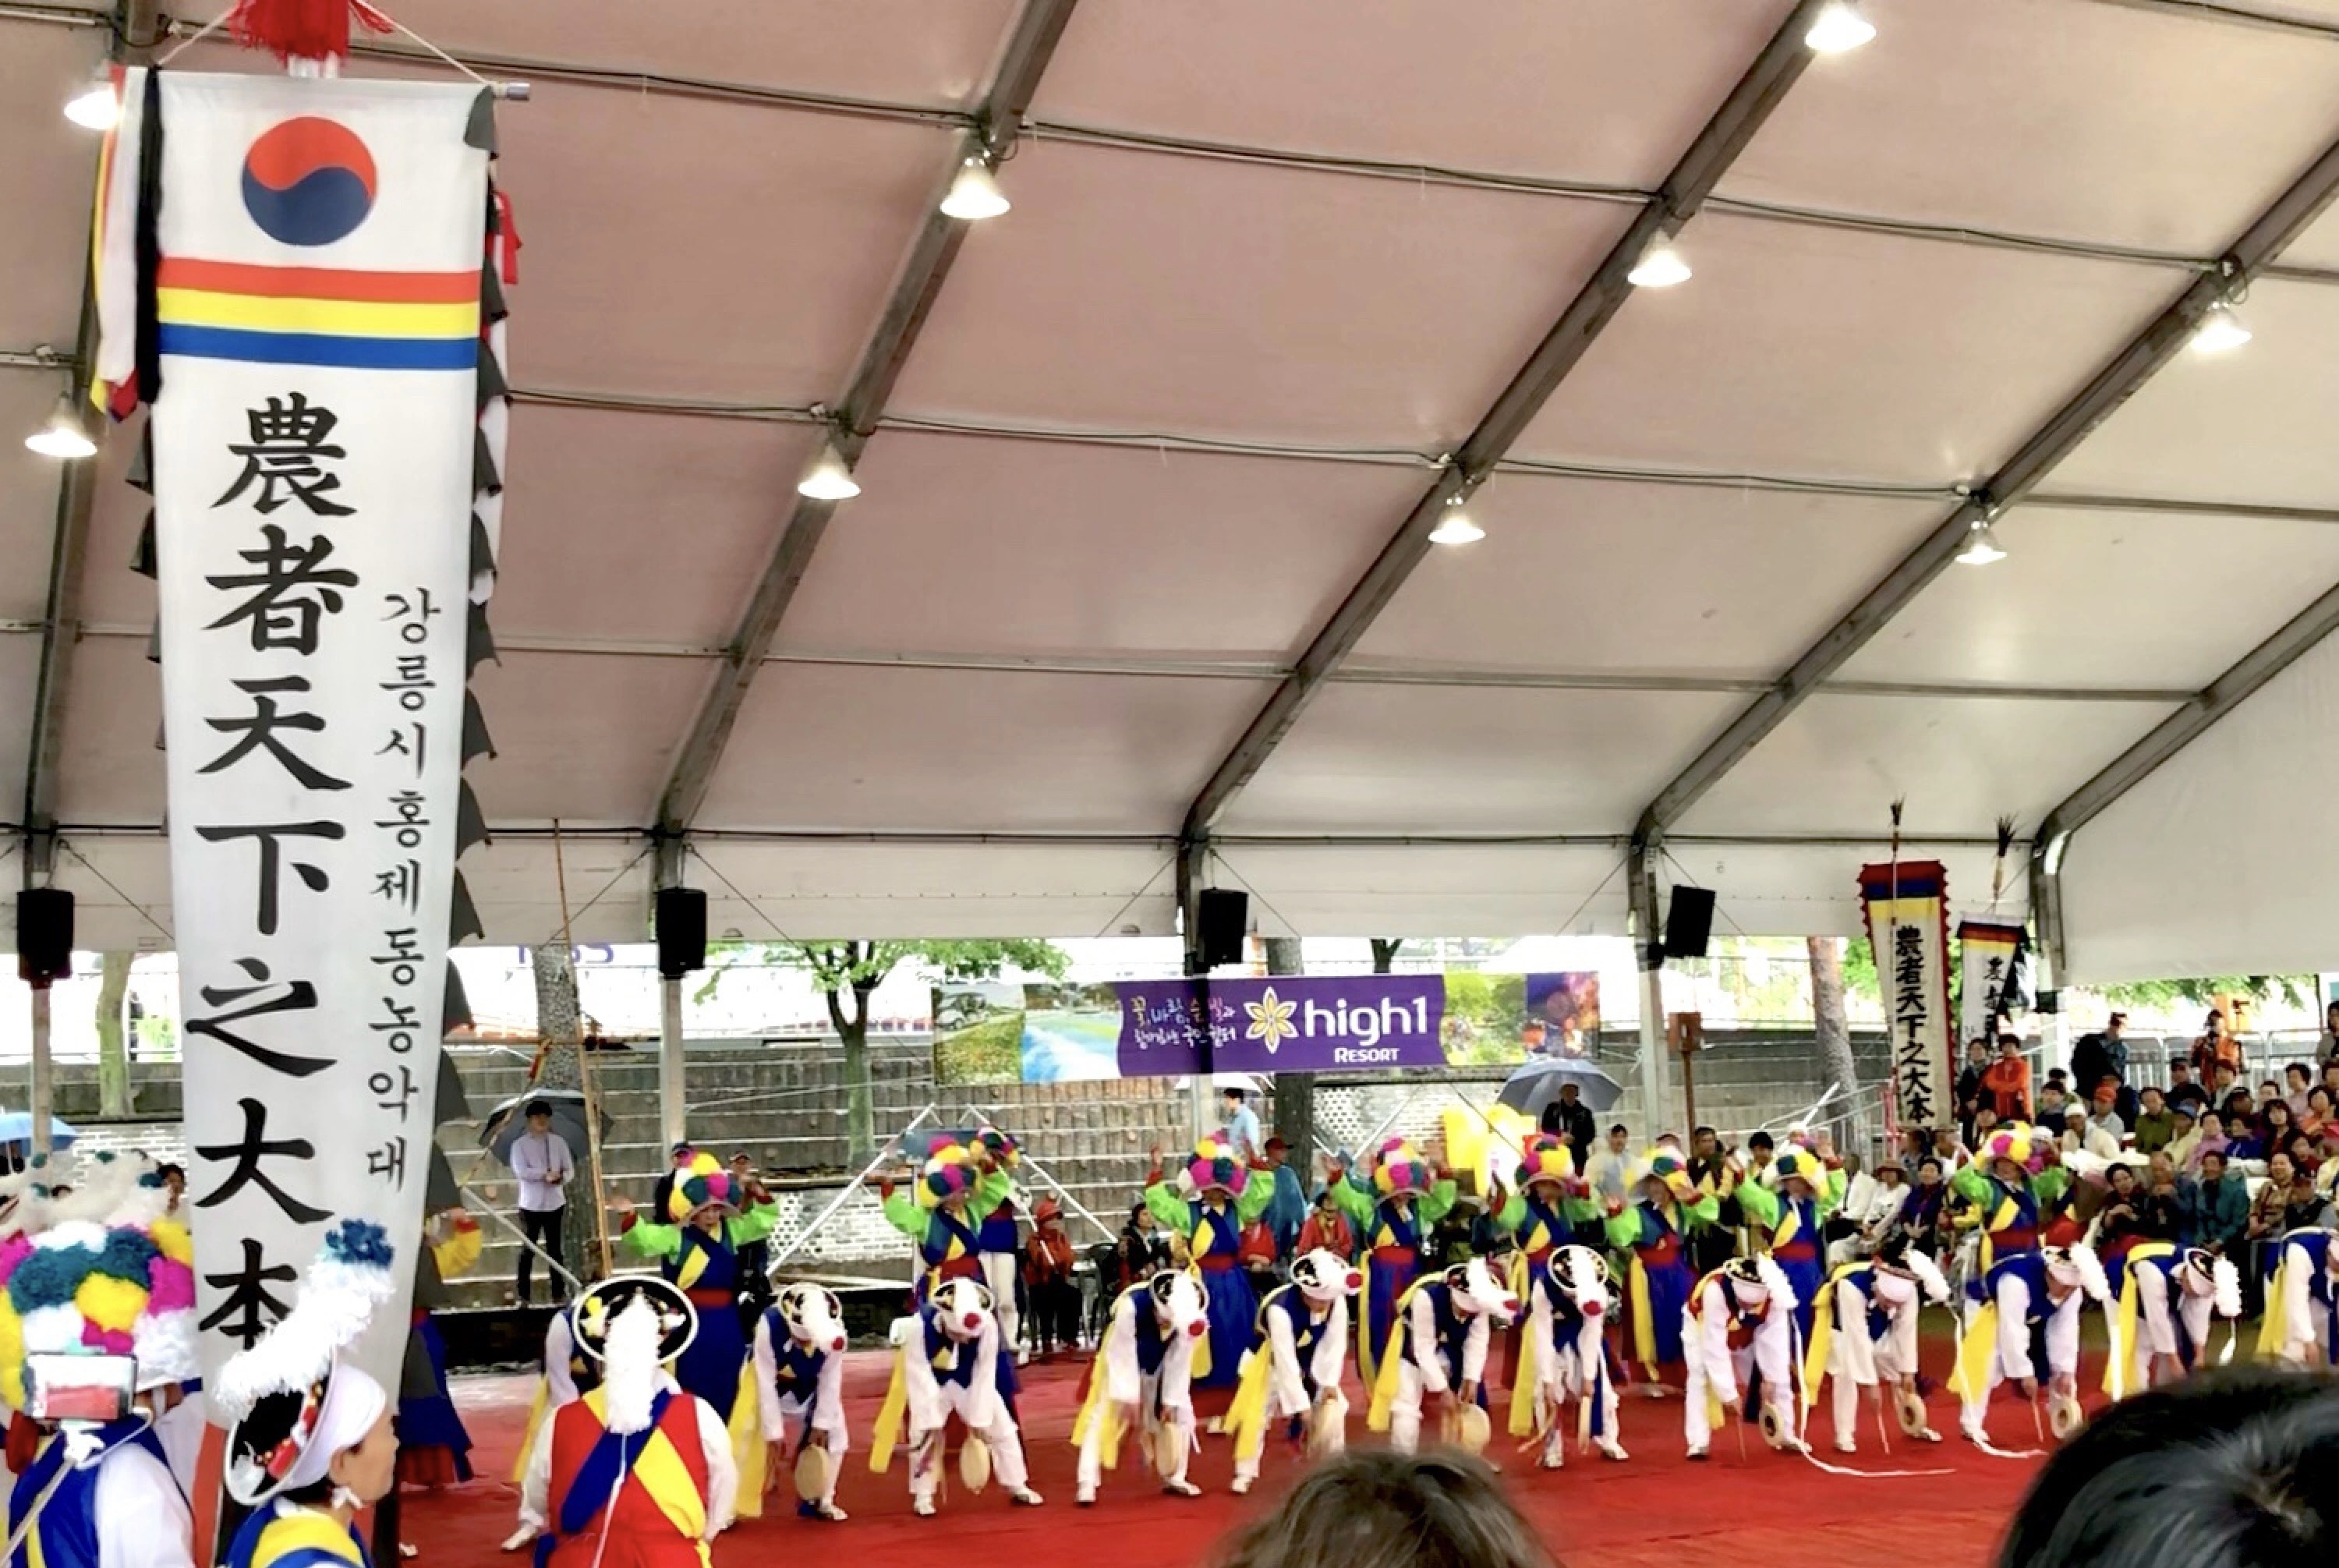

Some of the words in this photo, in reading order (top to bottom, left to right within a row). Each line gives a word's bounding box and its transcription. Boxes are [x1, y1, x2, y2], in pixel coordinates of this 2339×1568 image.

[185, 392, 359, 1350] 農者天下之大本
[1304, 996, 1428, 1046] high1
[1334, 1047, 1400, 1064] RESORT
[1895, 925, 1935, 1124] 農者天下之大本
